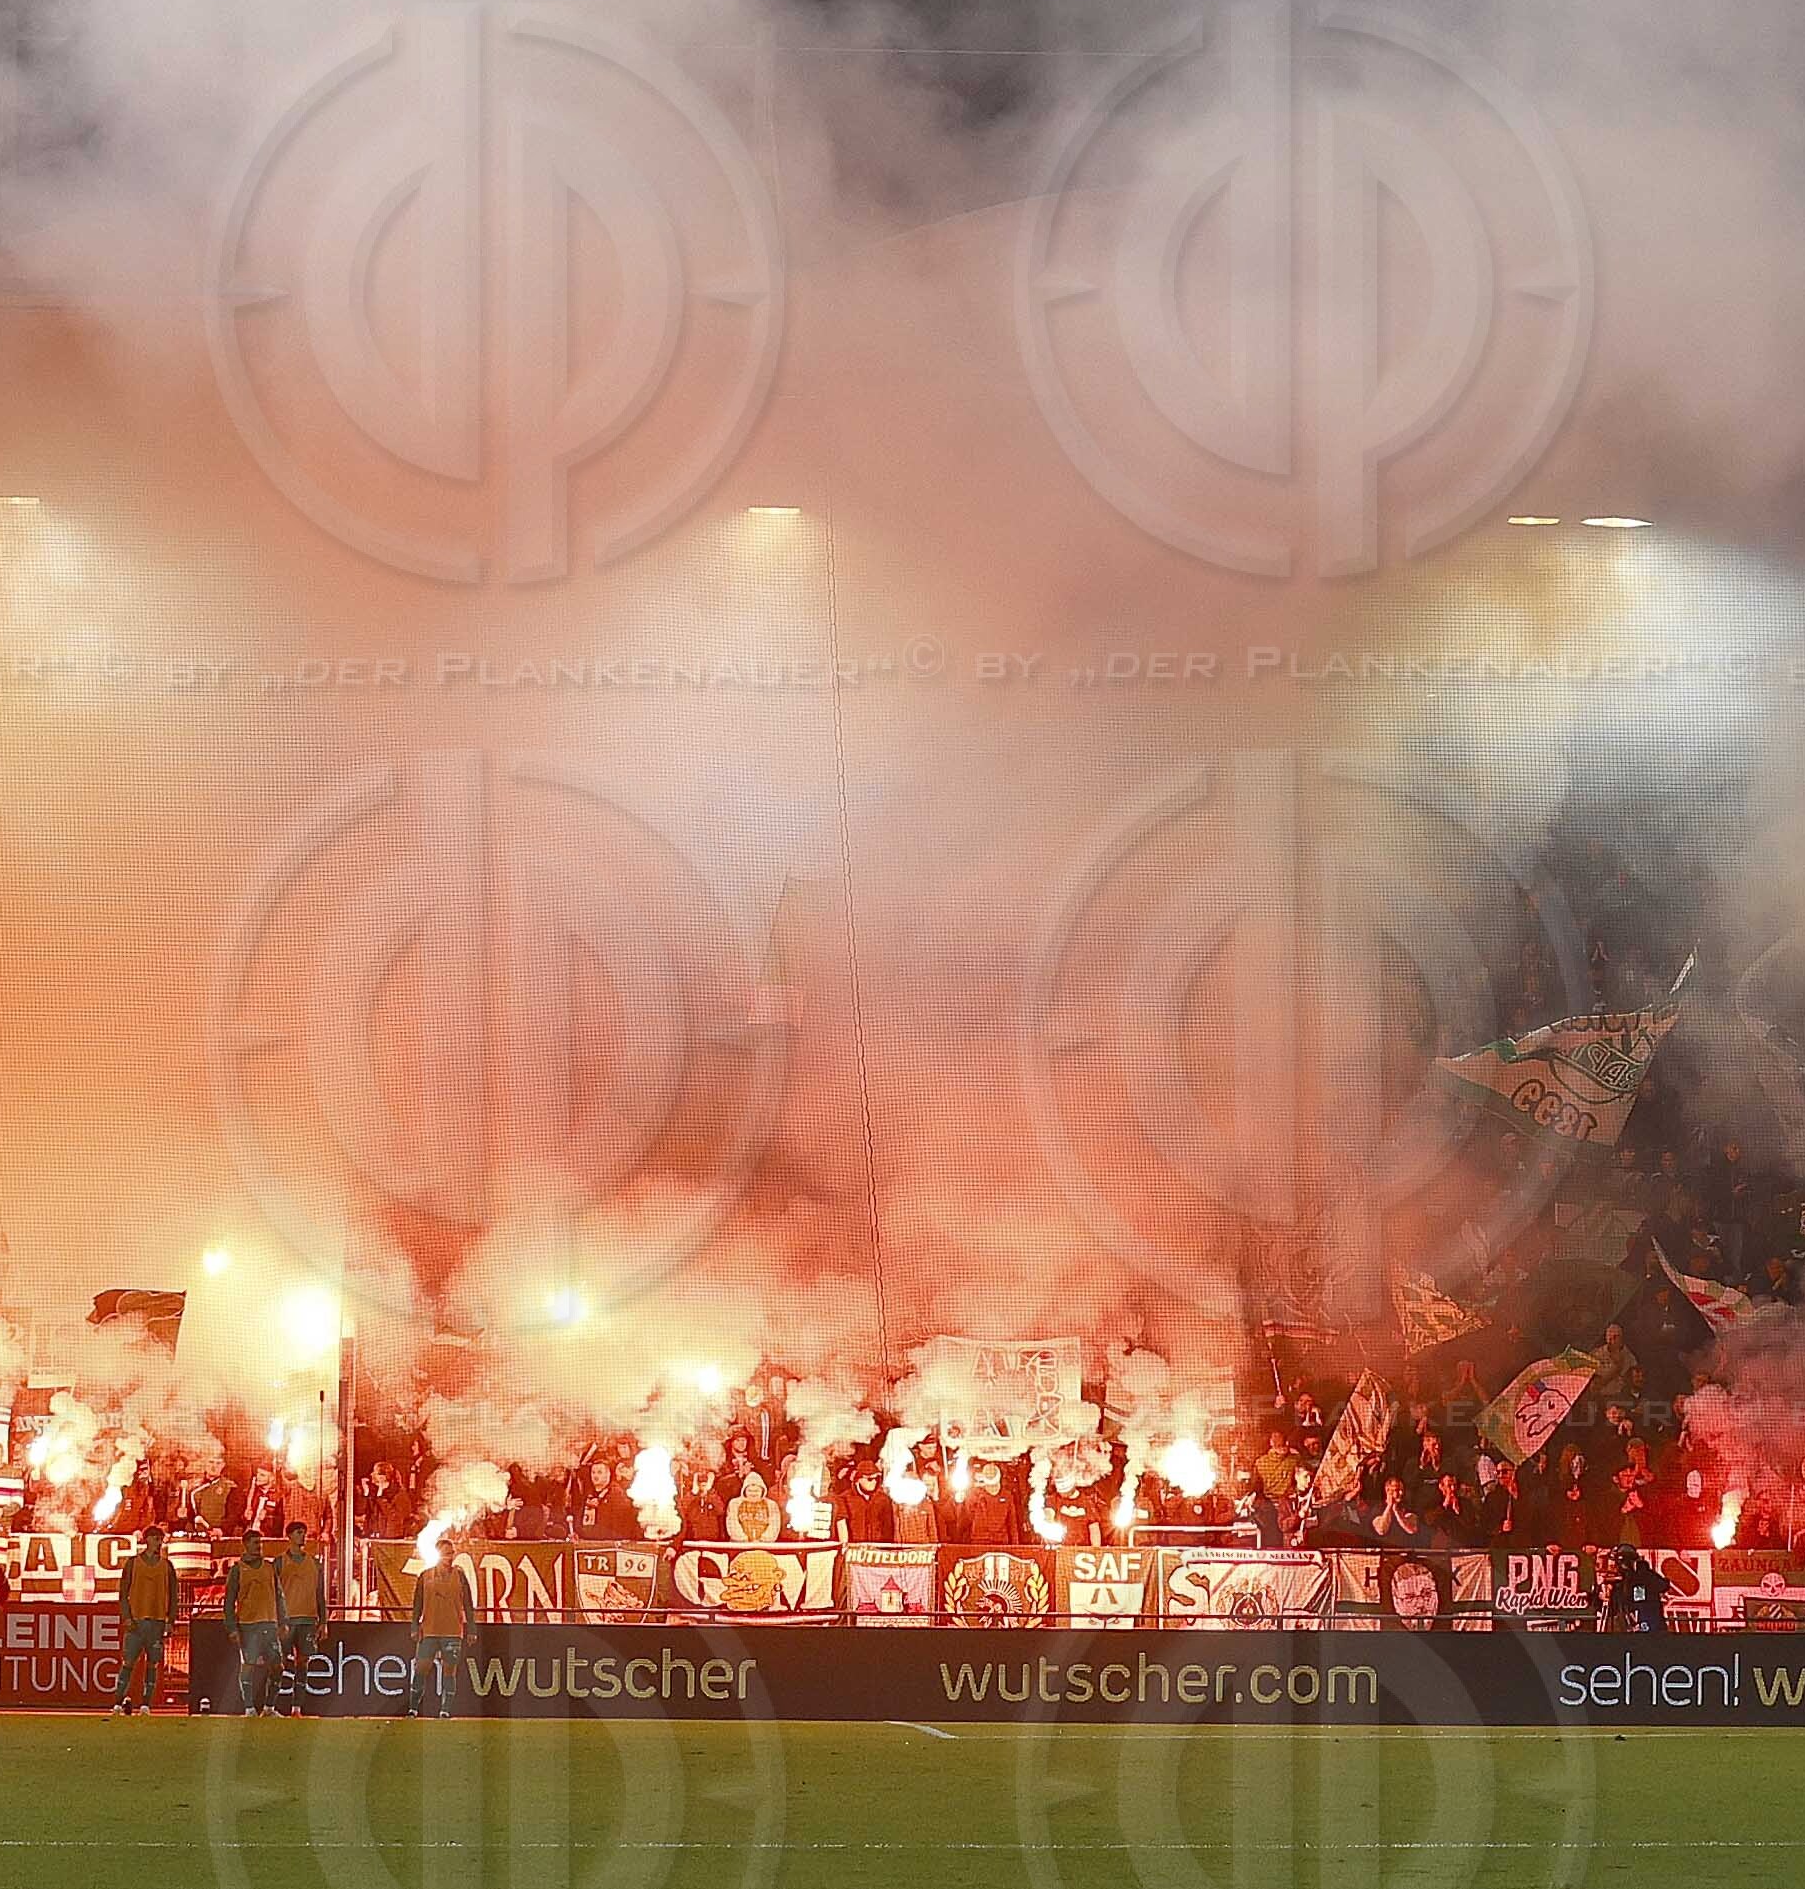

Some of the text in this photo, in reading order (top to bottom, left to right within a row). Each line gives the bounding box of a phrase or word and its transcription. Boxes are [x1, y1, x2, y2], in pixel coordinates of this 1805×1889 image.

[623, 1558, 647, 1573] 96
[846, 1549, 936, 1564] HÜTTELDORF
[1074, 1552, 1144, 1581] SAF
[1508, 1554, 1579, 1593] PNG
[1497, 1586, 1589, 1615] Rapid Wien
[466, 1647, 757, 1700] wutscher
[939, 1653, 1378, 1704] wutscher.com
[1559, 1652, 1740, 1707] sehen!
